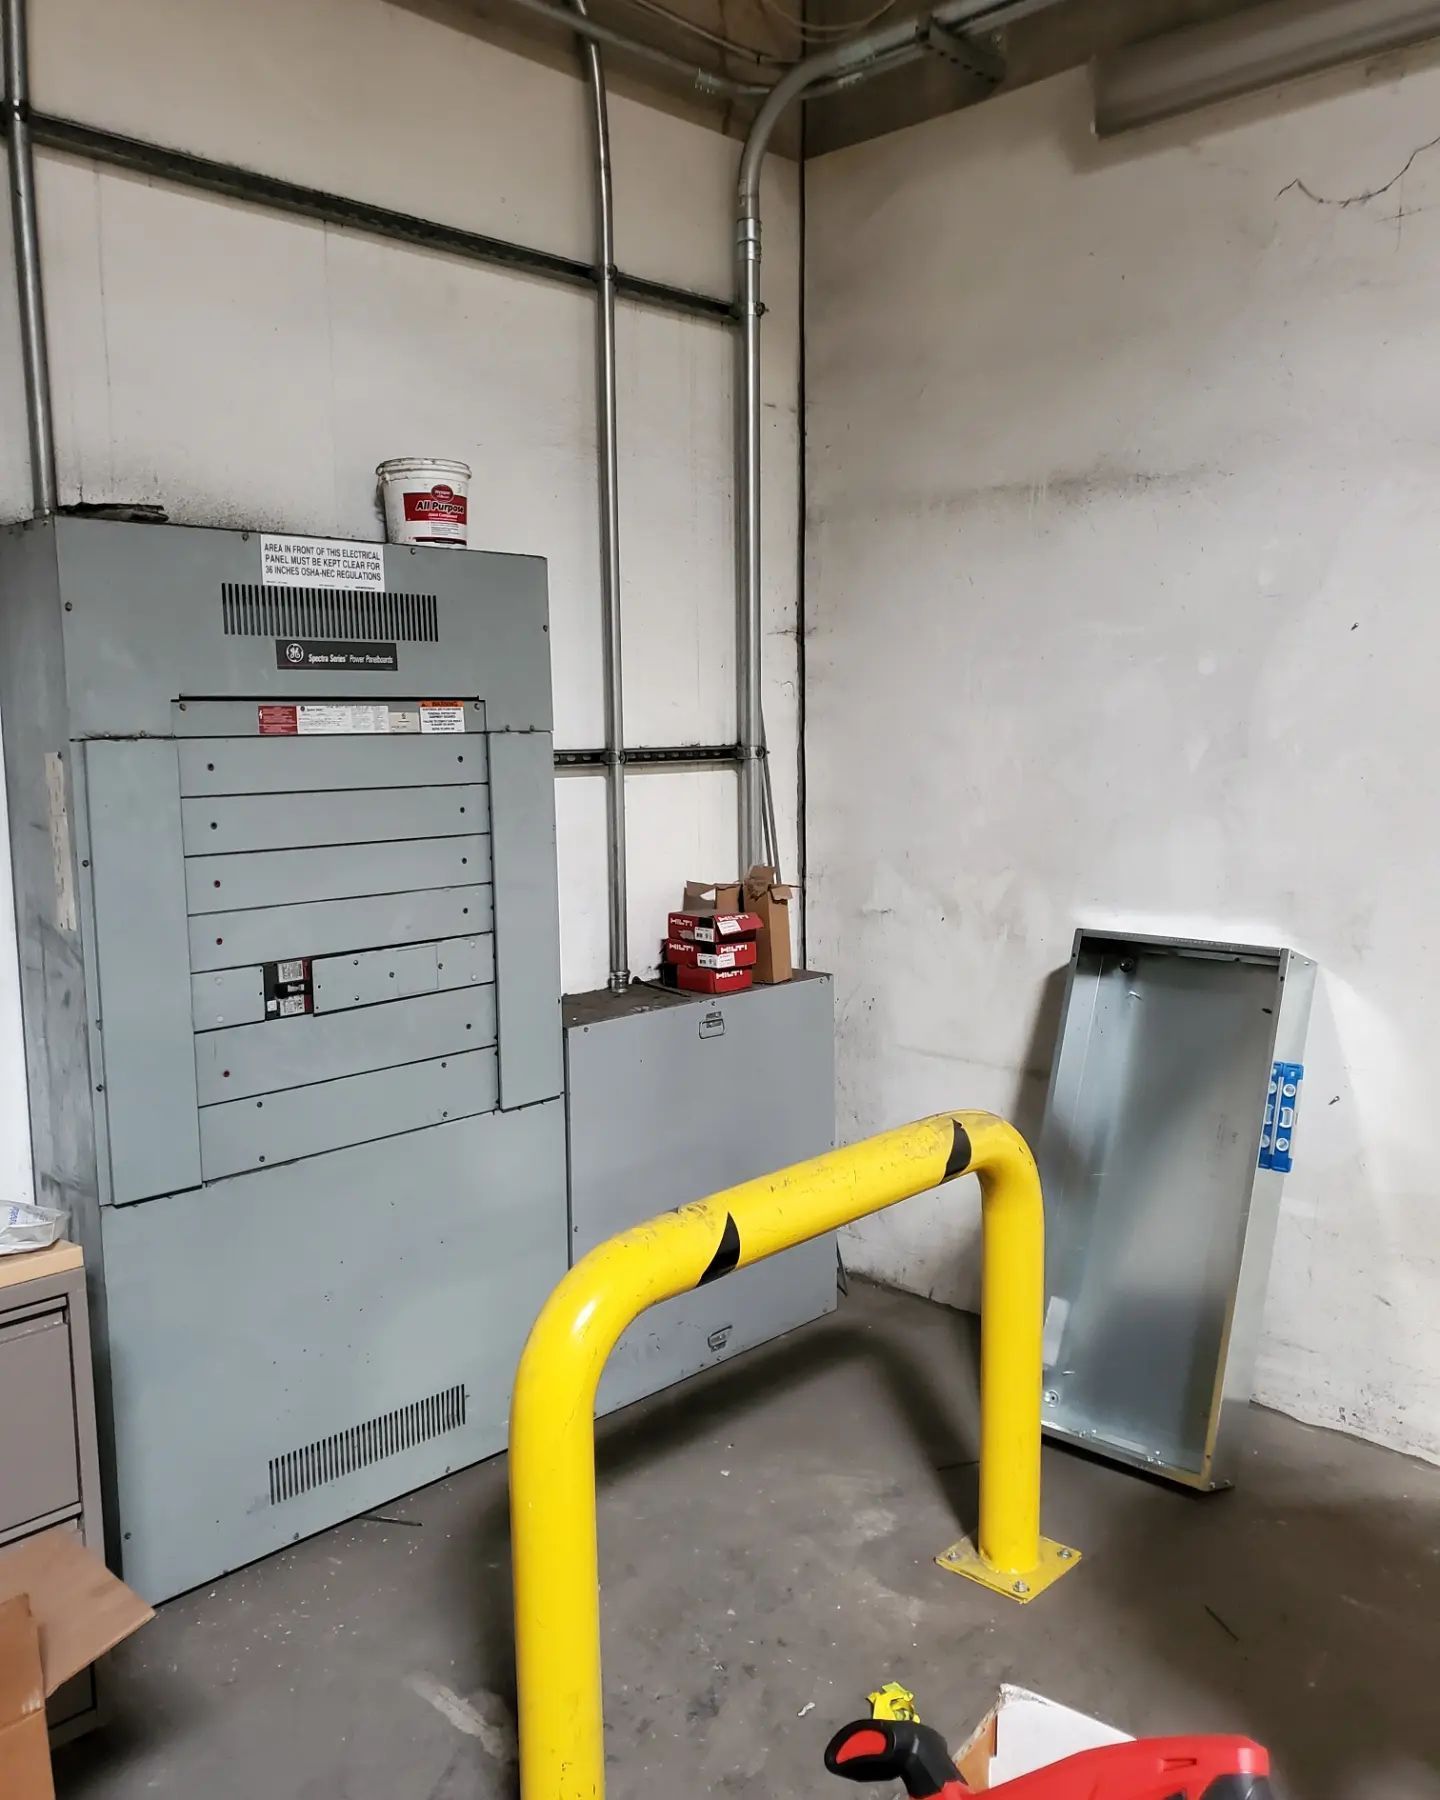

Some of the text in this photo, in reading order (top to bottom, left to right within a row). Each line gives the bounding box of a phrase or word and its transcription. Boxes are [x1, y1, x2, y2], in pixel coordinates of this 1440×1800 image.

[416, 500, 464, 514] All Purpose
[264, 543, 380, 560] AREA IN FRONT OF THIS ELECTRICAL
[265, 554, 380, 570] PANEL MUST BE KEPT CLEAR FOR
[265, 565, 381, 581] 36 INCHES OSHA-NEC REGULATIONS
[308, 653, 329, 664] Spectra
[349, 655, 365, 663] Power
[366, 655, 394, 664] Panelboards
[670, 917, 693, 927] HILTI
[669, 943, 694, 952] HILTI
[720, 944, 748, 953] HILTI
[715, 969, 743, 980] HILTI
